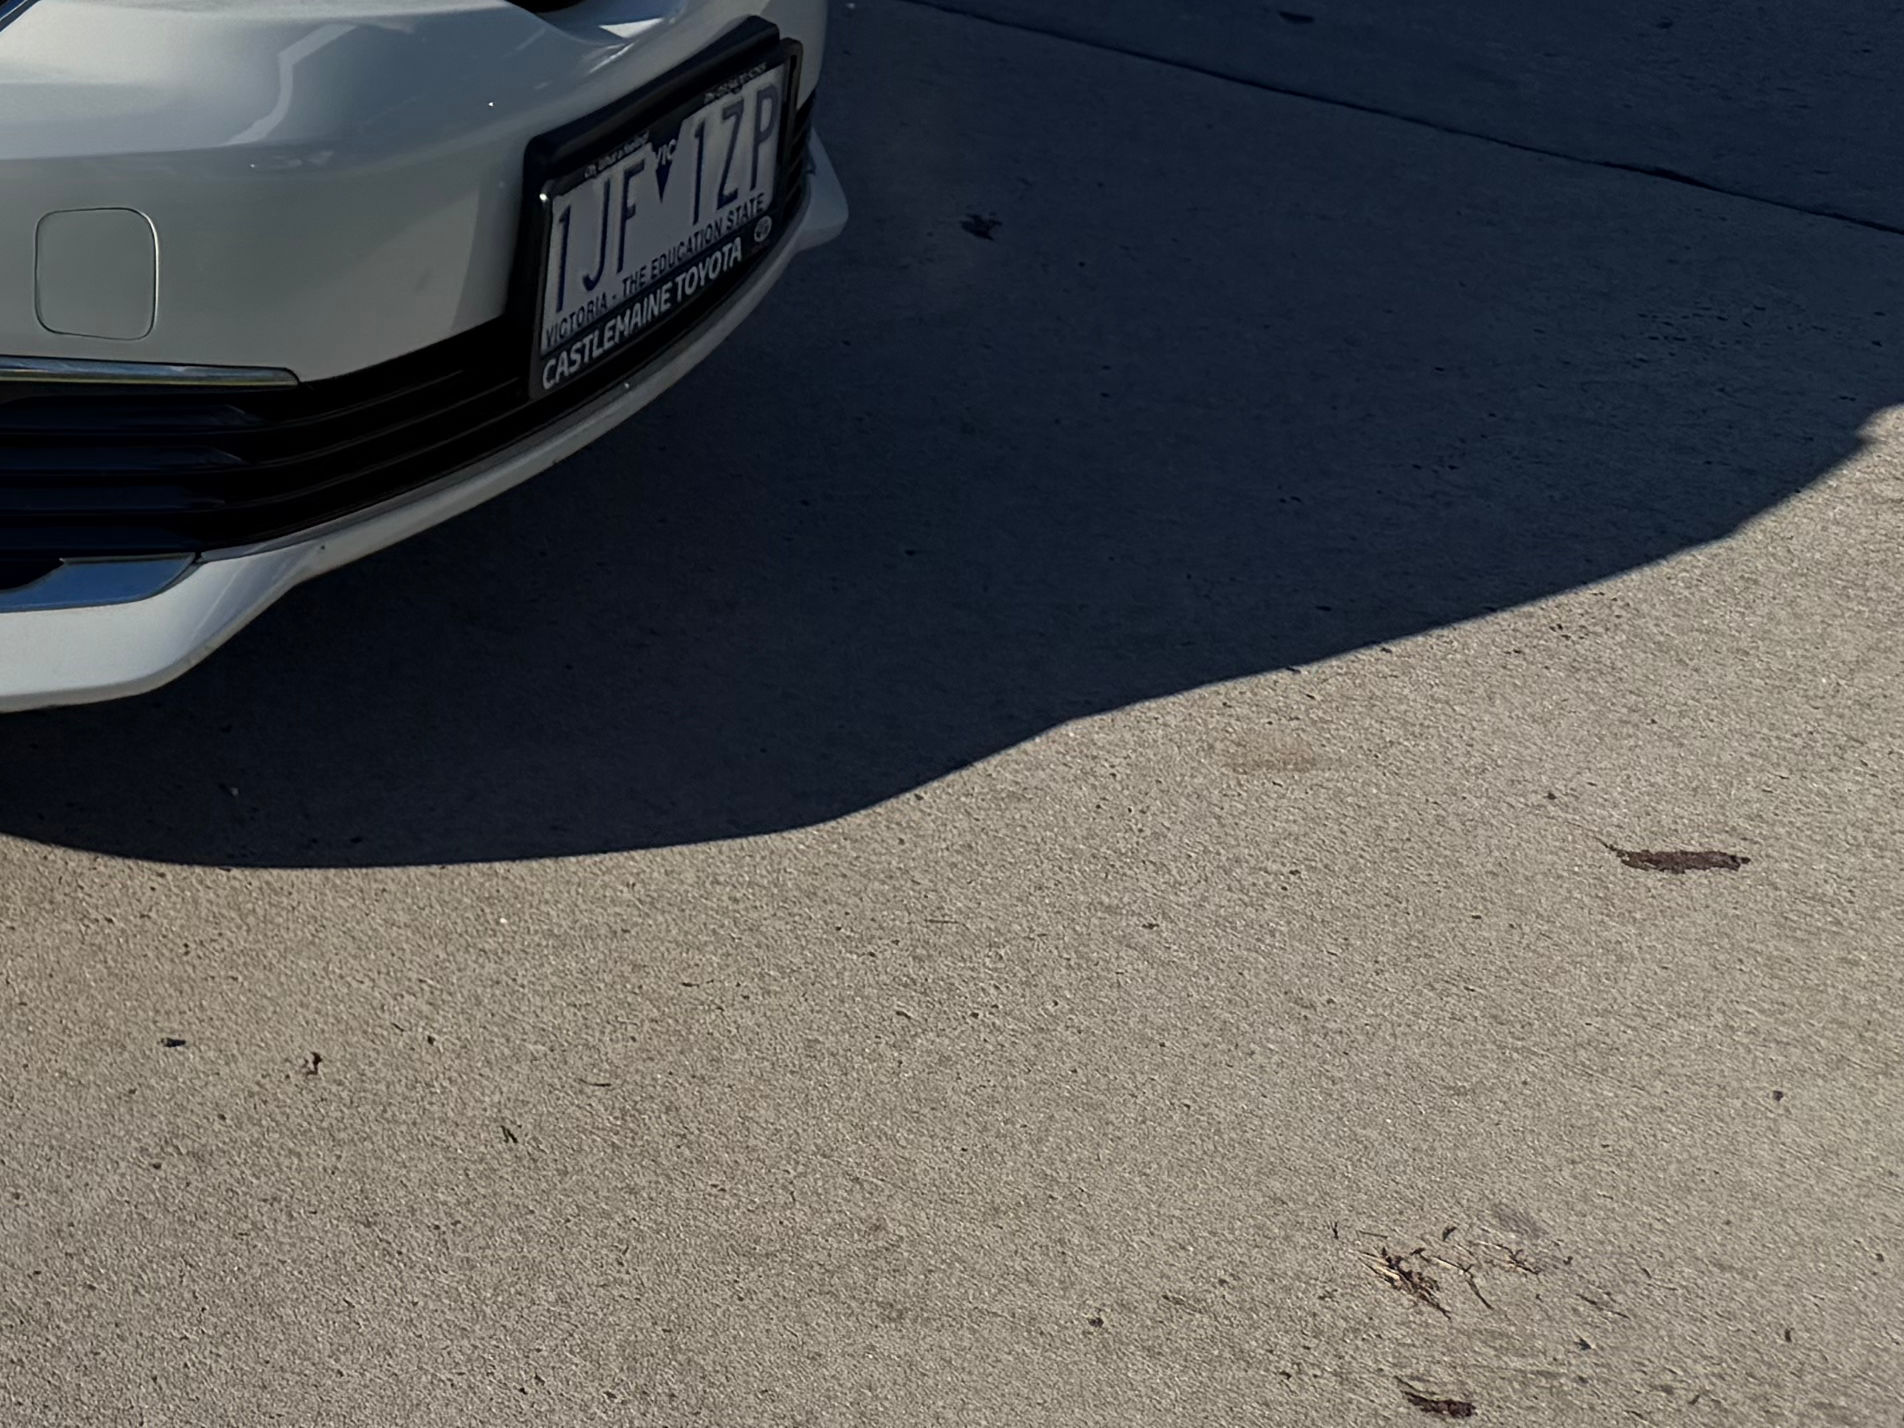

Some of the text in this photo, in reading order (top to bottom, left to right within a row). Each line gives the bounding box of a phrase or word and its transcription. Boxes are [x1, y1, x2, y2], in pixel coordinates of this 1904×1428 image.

[554, 83, 779, 313] 1JF 1ZP
[655, 138, 677, 165] VIC
[542, 236, 744, 391] CASTLEMAINE TOYOTA
[545, 297, 608, 348] VICTORIA
[622, 267, 647, 296] THE
[650, 222, 724, 283] EDUCATION
[726, 193, 766, 232] STATE
